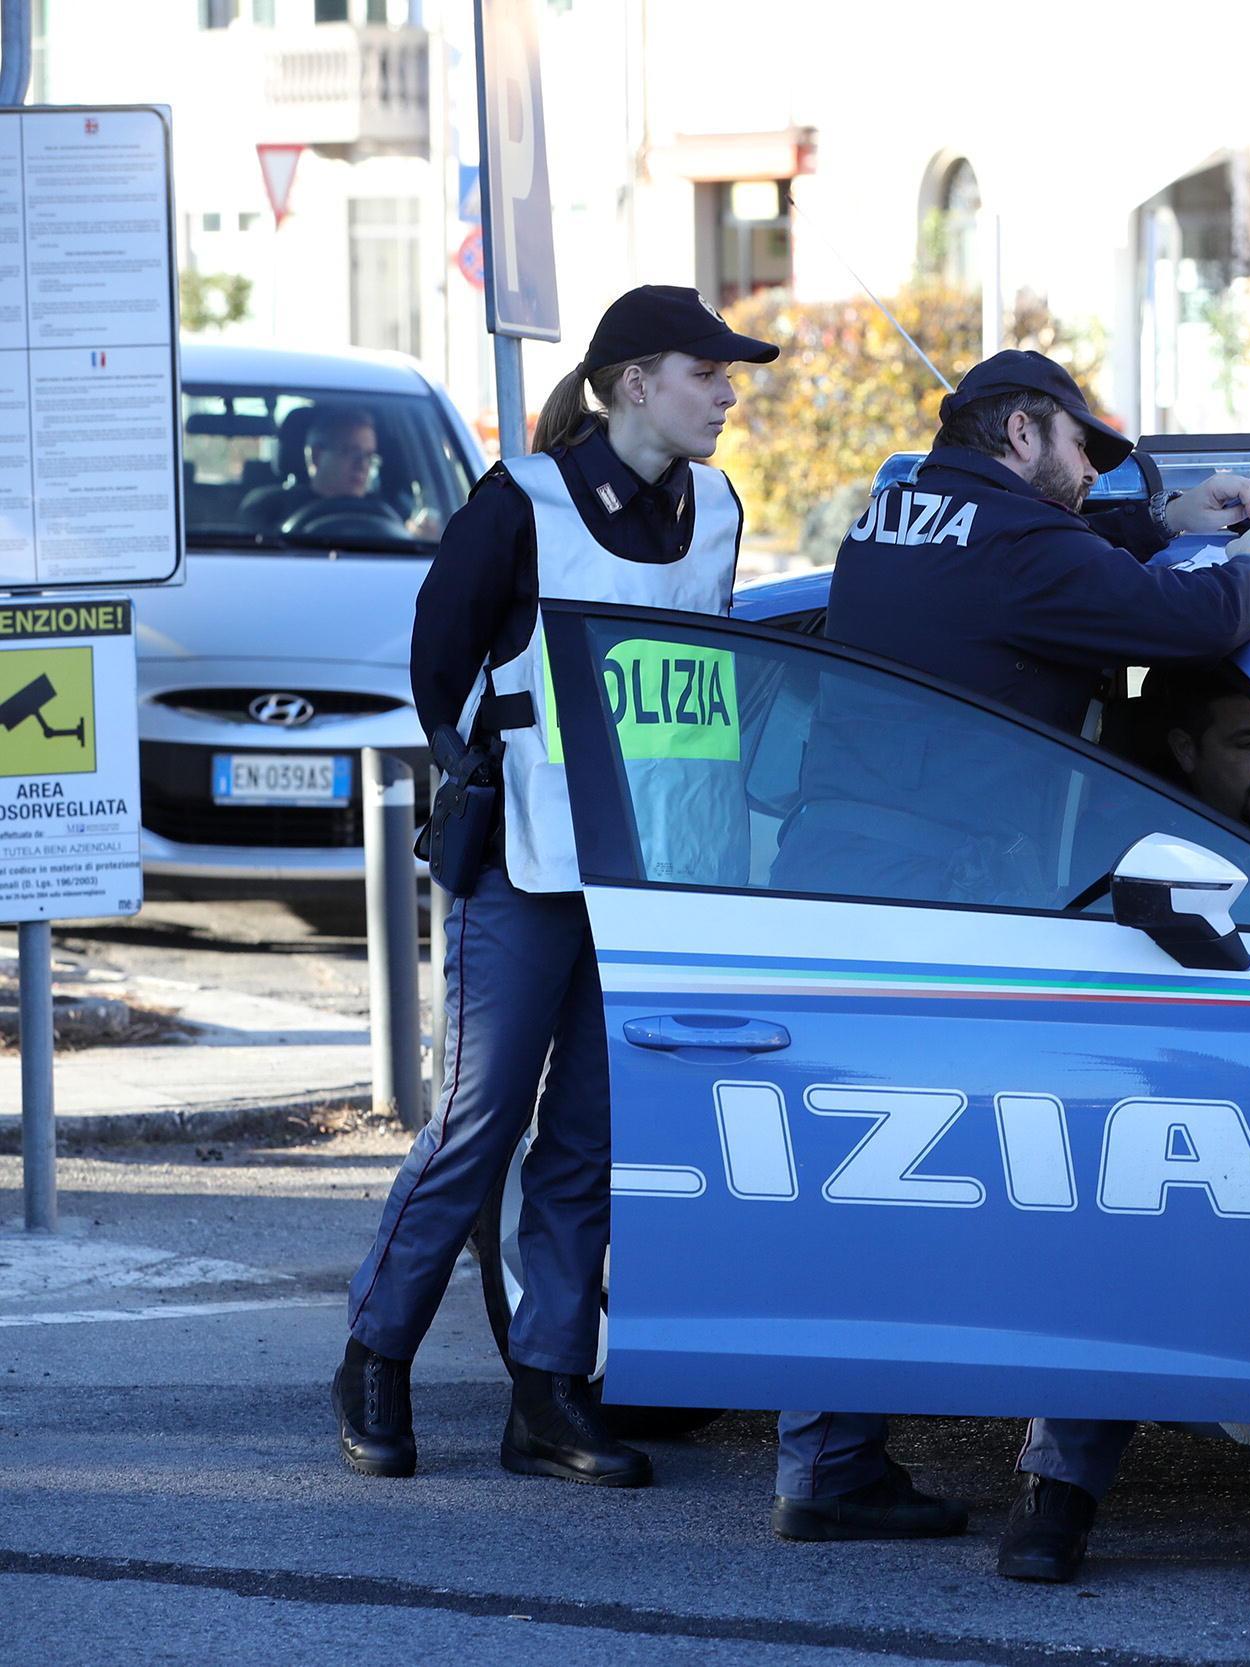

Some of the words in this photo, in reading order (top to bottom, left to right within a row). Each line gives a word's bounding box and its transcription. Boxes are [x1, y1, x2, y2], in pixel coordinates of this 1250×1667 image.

[843, 489, 978, 547] OLIZIA
[0, 606, 123, 634] ENZIONE!
[602, 658, 731, 727] OLIZIA
[234, 763, 258, 789] EN
[16, 782, 64, 799] AREA
[4, 846, 41, 857] TUTELA
[43, 845, 67, 855] BENI
[69, 842, 121, 853] AZIENDALI
[9, 865, 37, 875] codice
[39, 864, 48, 874] in
[49, 862, 82, 873] materia
